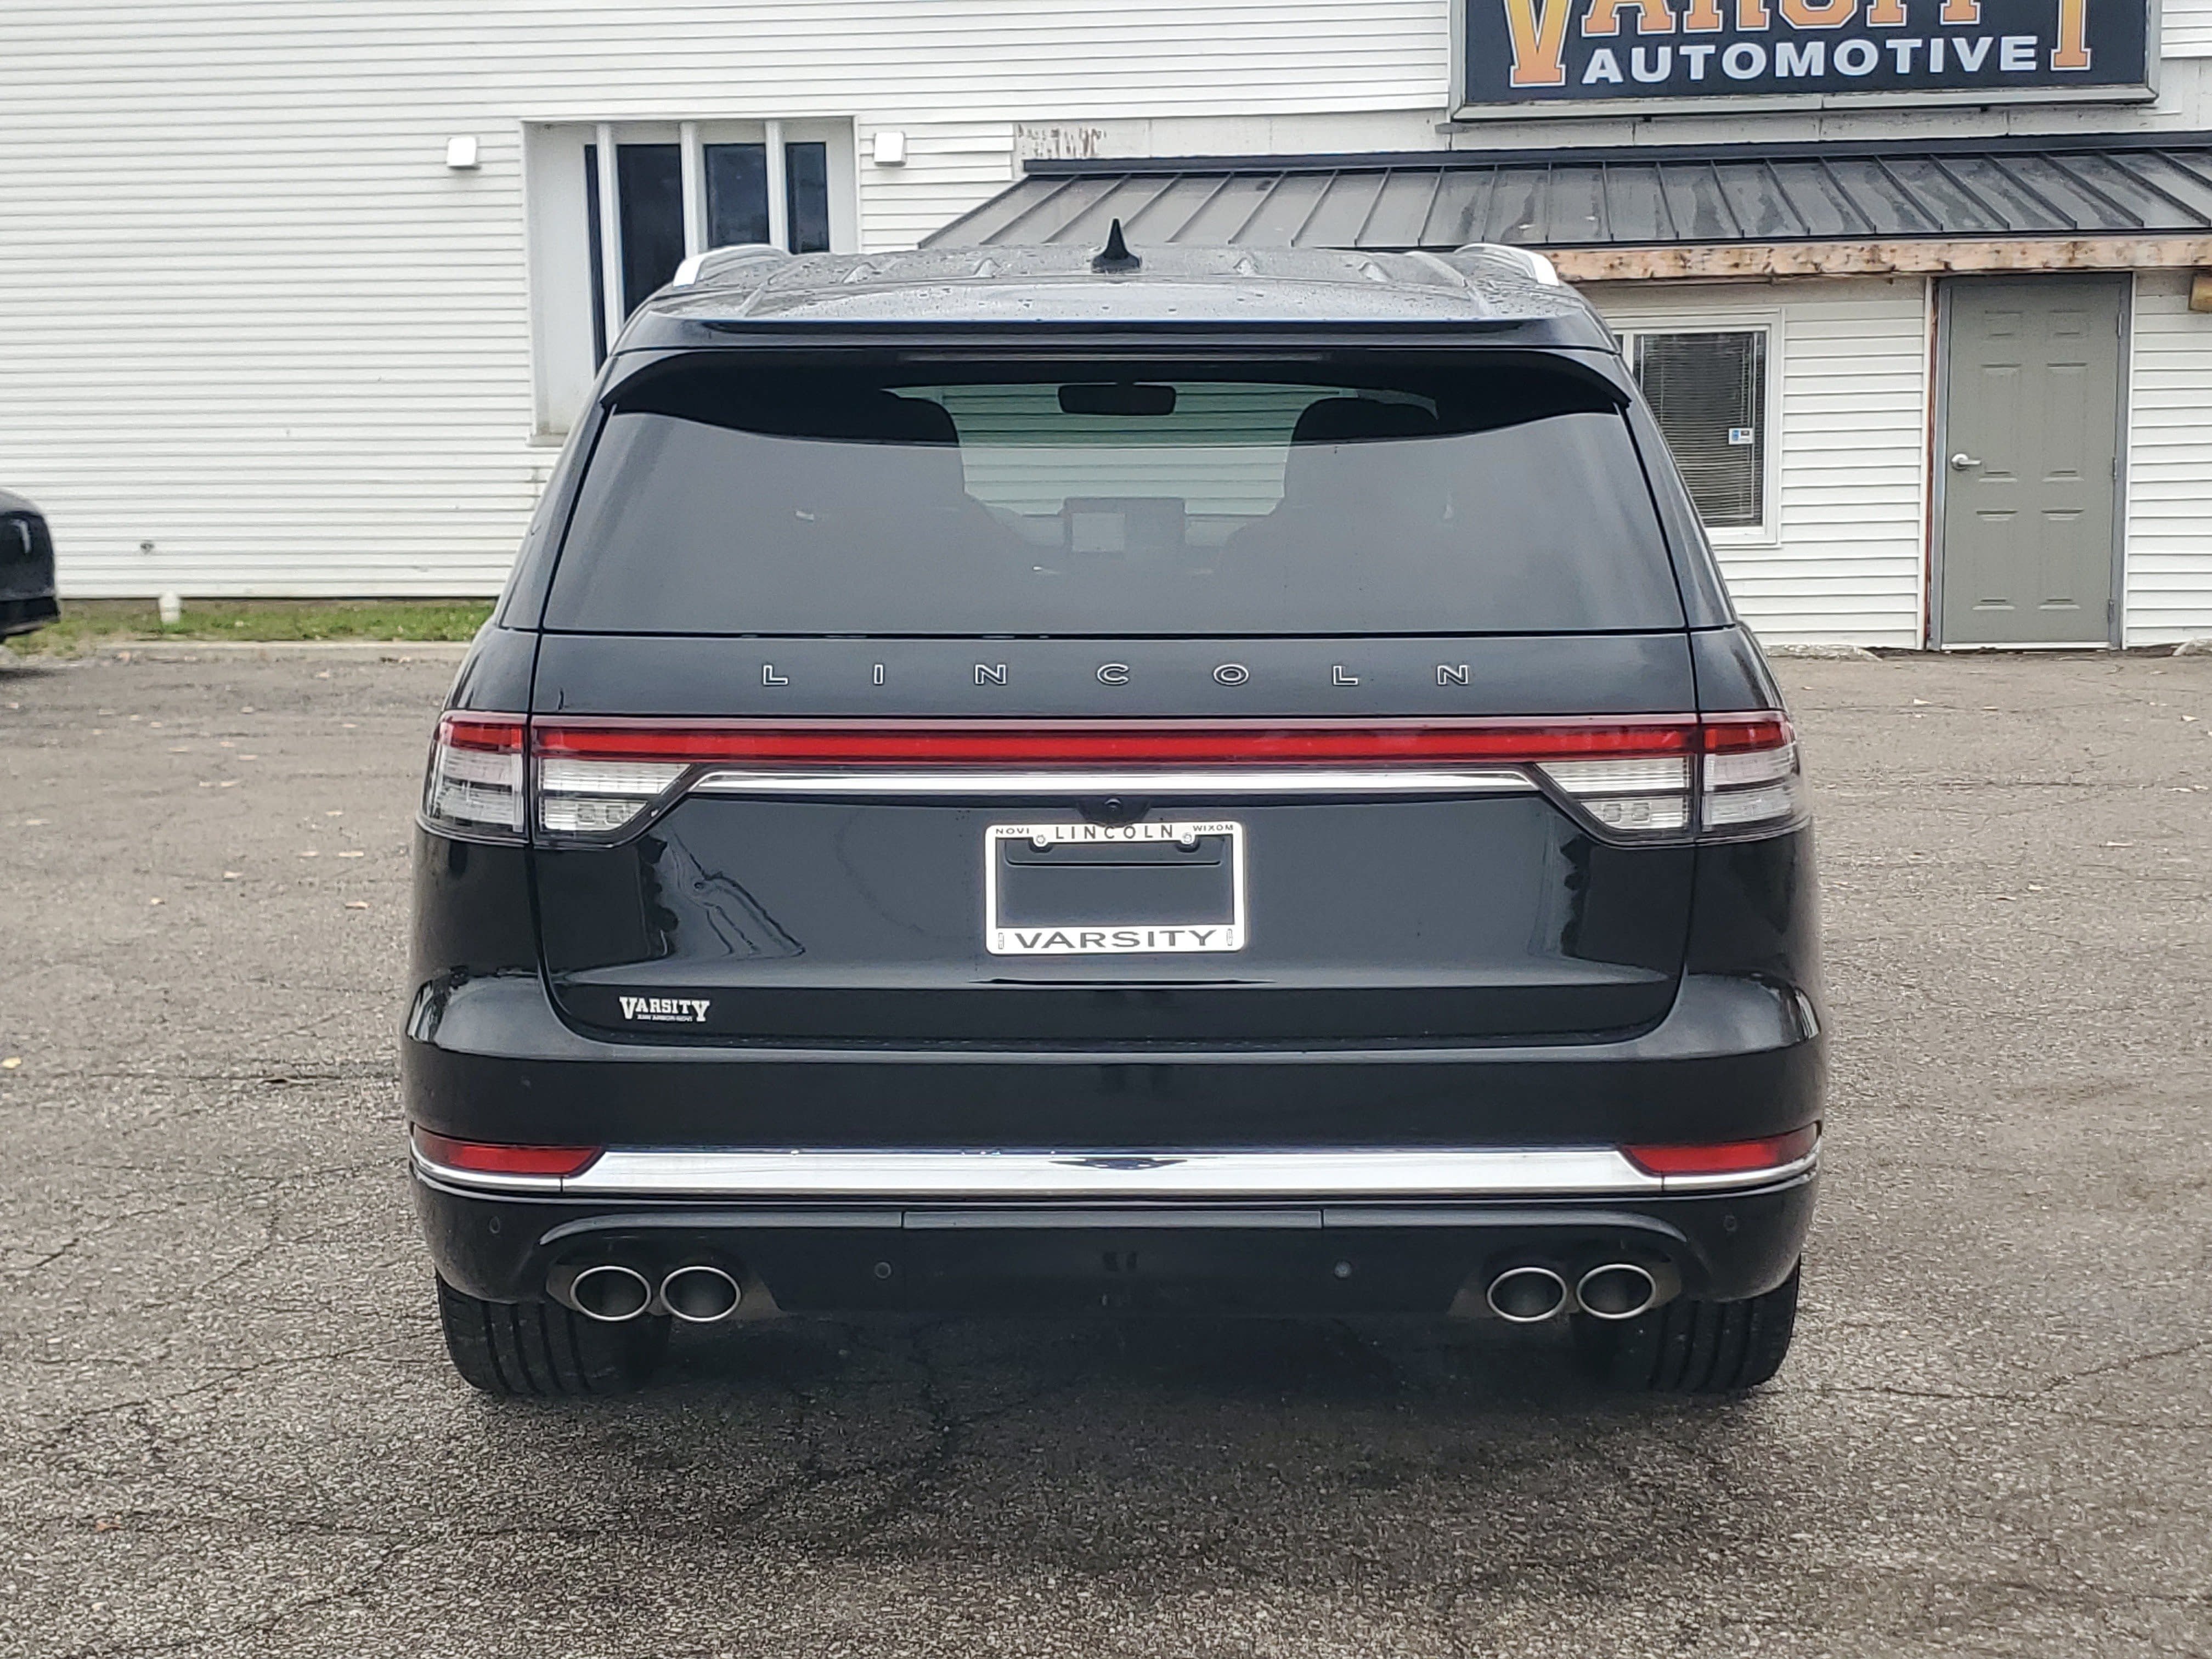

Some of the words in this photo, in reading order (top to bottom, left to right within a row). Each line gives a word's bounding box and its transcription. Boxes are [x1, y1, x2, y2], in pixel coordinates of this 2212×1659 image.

[1582, 36, 2038, 84] AUTOMOTIVE
[761, 664, 1468, 687] LINCOLN
[1056, 825, 1173, 840] LINCOLN
[1014, 929, 1217, 949] VARSITY
[619, 996, 710, 1022] VARSITY
